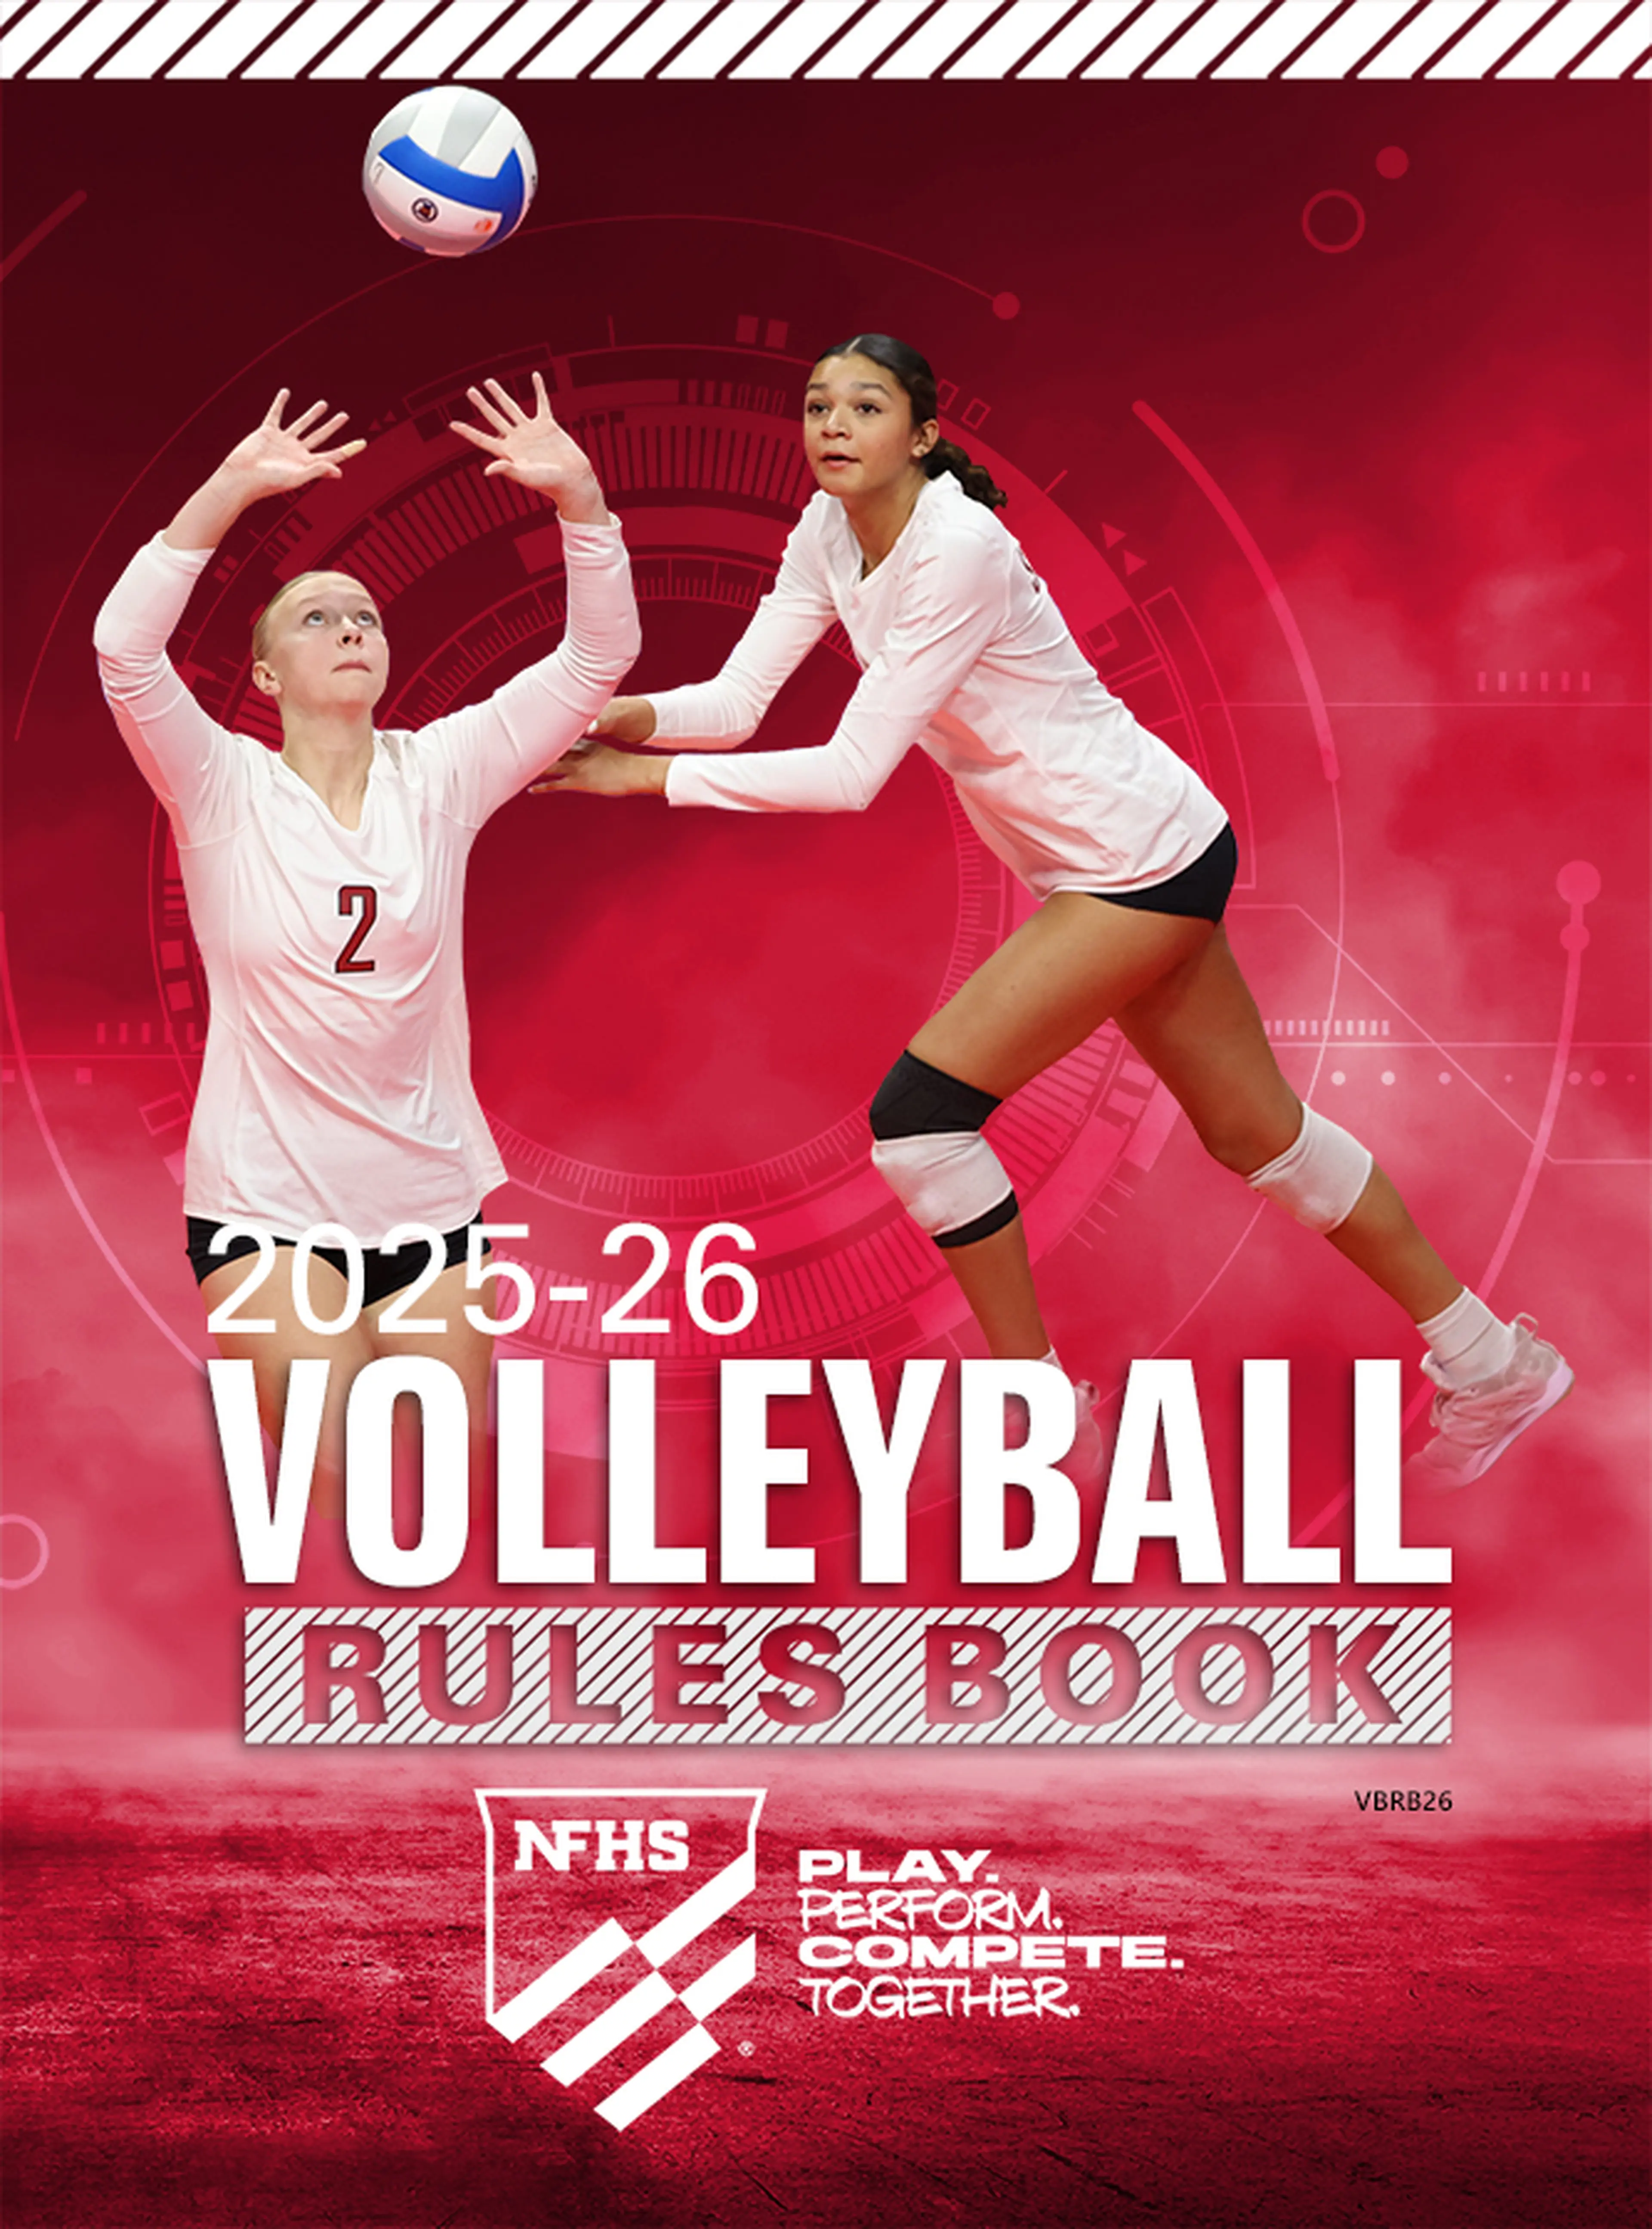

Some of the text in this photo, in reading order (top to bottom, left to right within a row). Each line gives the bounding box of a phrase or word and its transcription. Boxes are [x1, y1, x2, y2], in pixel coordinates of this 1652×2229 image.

[335, 885, 377, 974] 2
[207, 1222, 758, 1335] 2025-26
[207, 1354, 1452, 1587] VOLLEYBALL
[301, 1622, 1404, 1726] RULES BOOK
[1354, 1790, 1453, 1812] VBRB26
[514, 1819, 689, 1871] NFHS
[798, 1850, 999, 1883] PLAY.
[798, 1888, 1063, 1933] PERFORM.
[798, 1936, 1184, 1969] COMPETE.
[798, 1974, 1080, 2019] TOGETHER.
